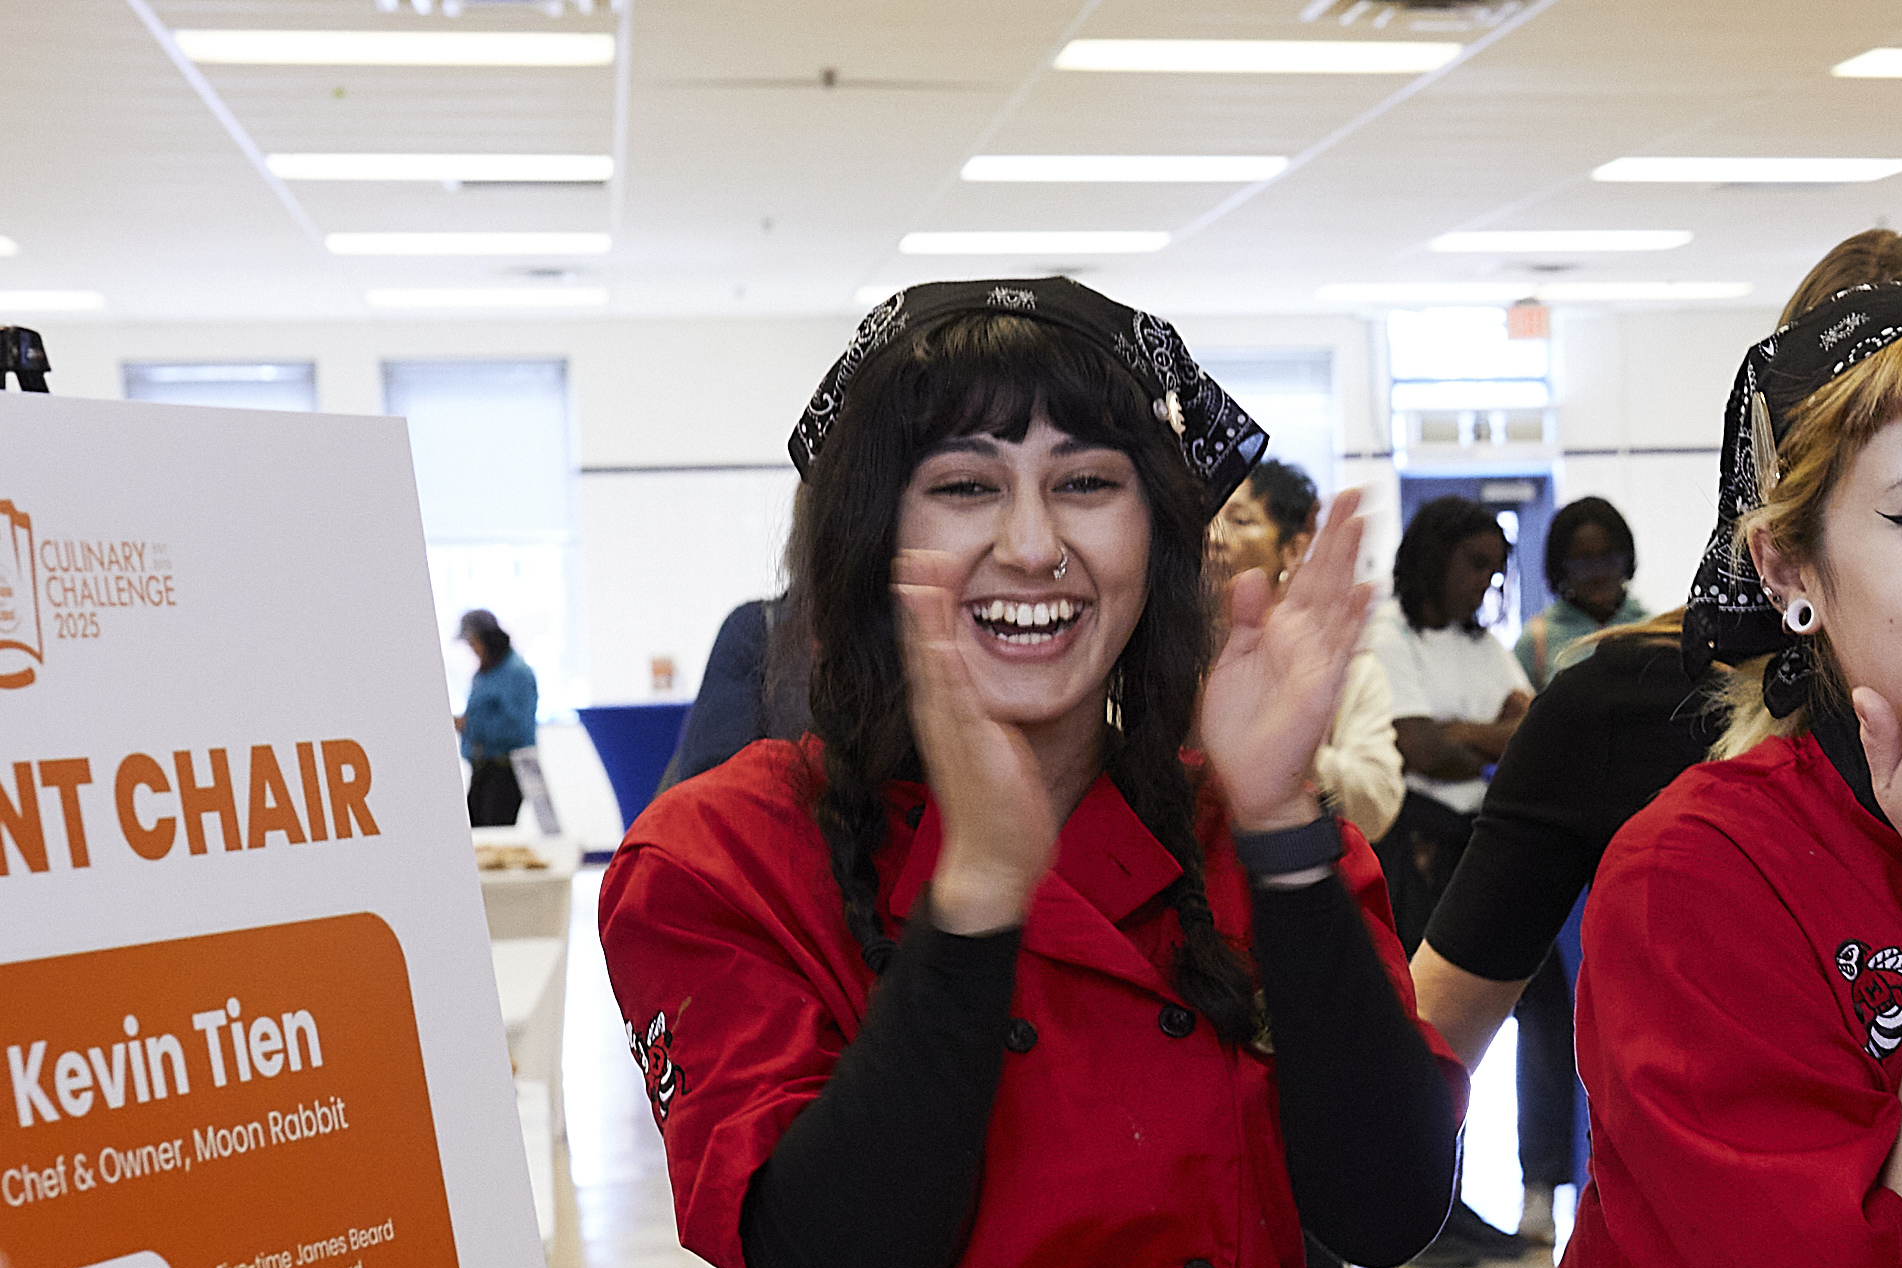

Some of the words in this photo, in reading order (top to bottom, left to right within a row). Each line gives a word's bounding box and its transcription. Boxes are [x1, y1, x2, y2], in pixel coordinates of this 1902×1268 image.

[40, 538, 147, 573] CULINARY
[45, 574, 177, 607] CHALLENGE
[54, 611, 100, 638] 2025
[114, 737, 381, 861] CHAIR
[7, 1014, 190, 1128] Kevin
[192, 996, 323, 1087] Tien
[1, 1154, 66, 1207] Chef
[74, 1152, 95, 1192] &
[99, 1138, 191, 1188] Owner,
[193, 1120, 265, 1163] Moon
[268, 1096, 349, 1146] Rabbit
[296, 1236, 347, 1265] James
[348, 1219, 394, 1249] Beard
